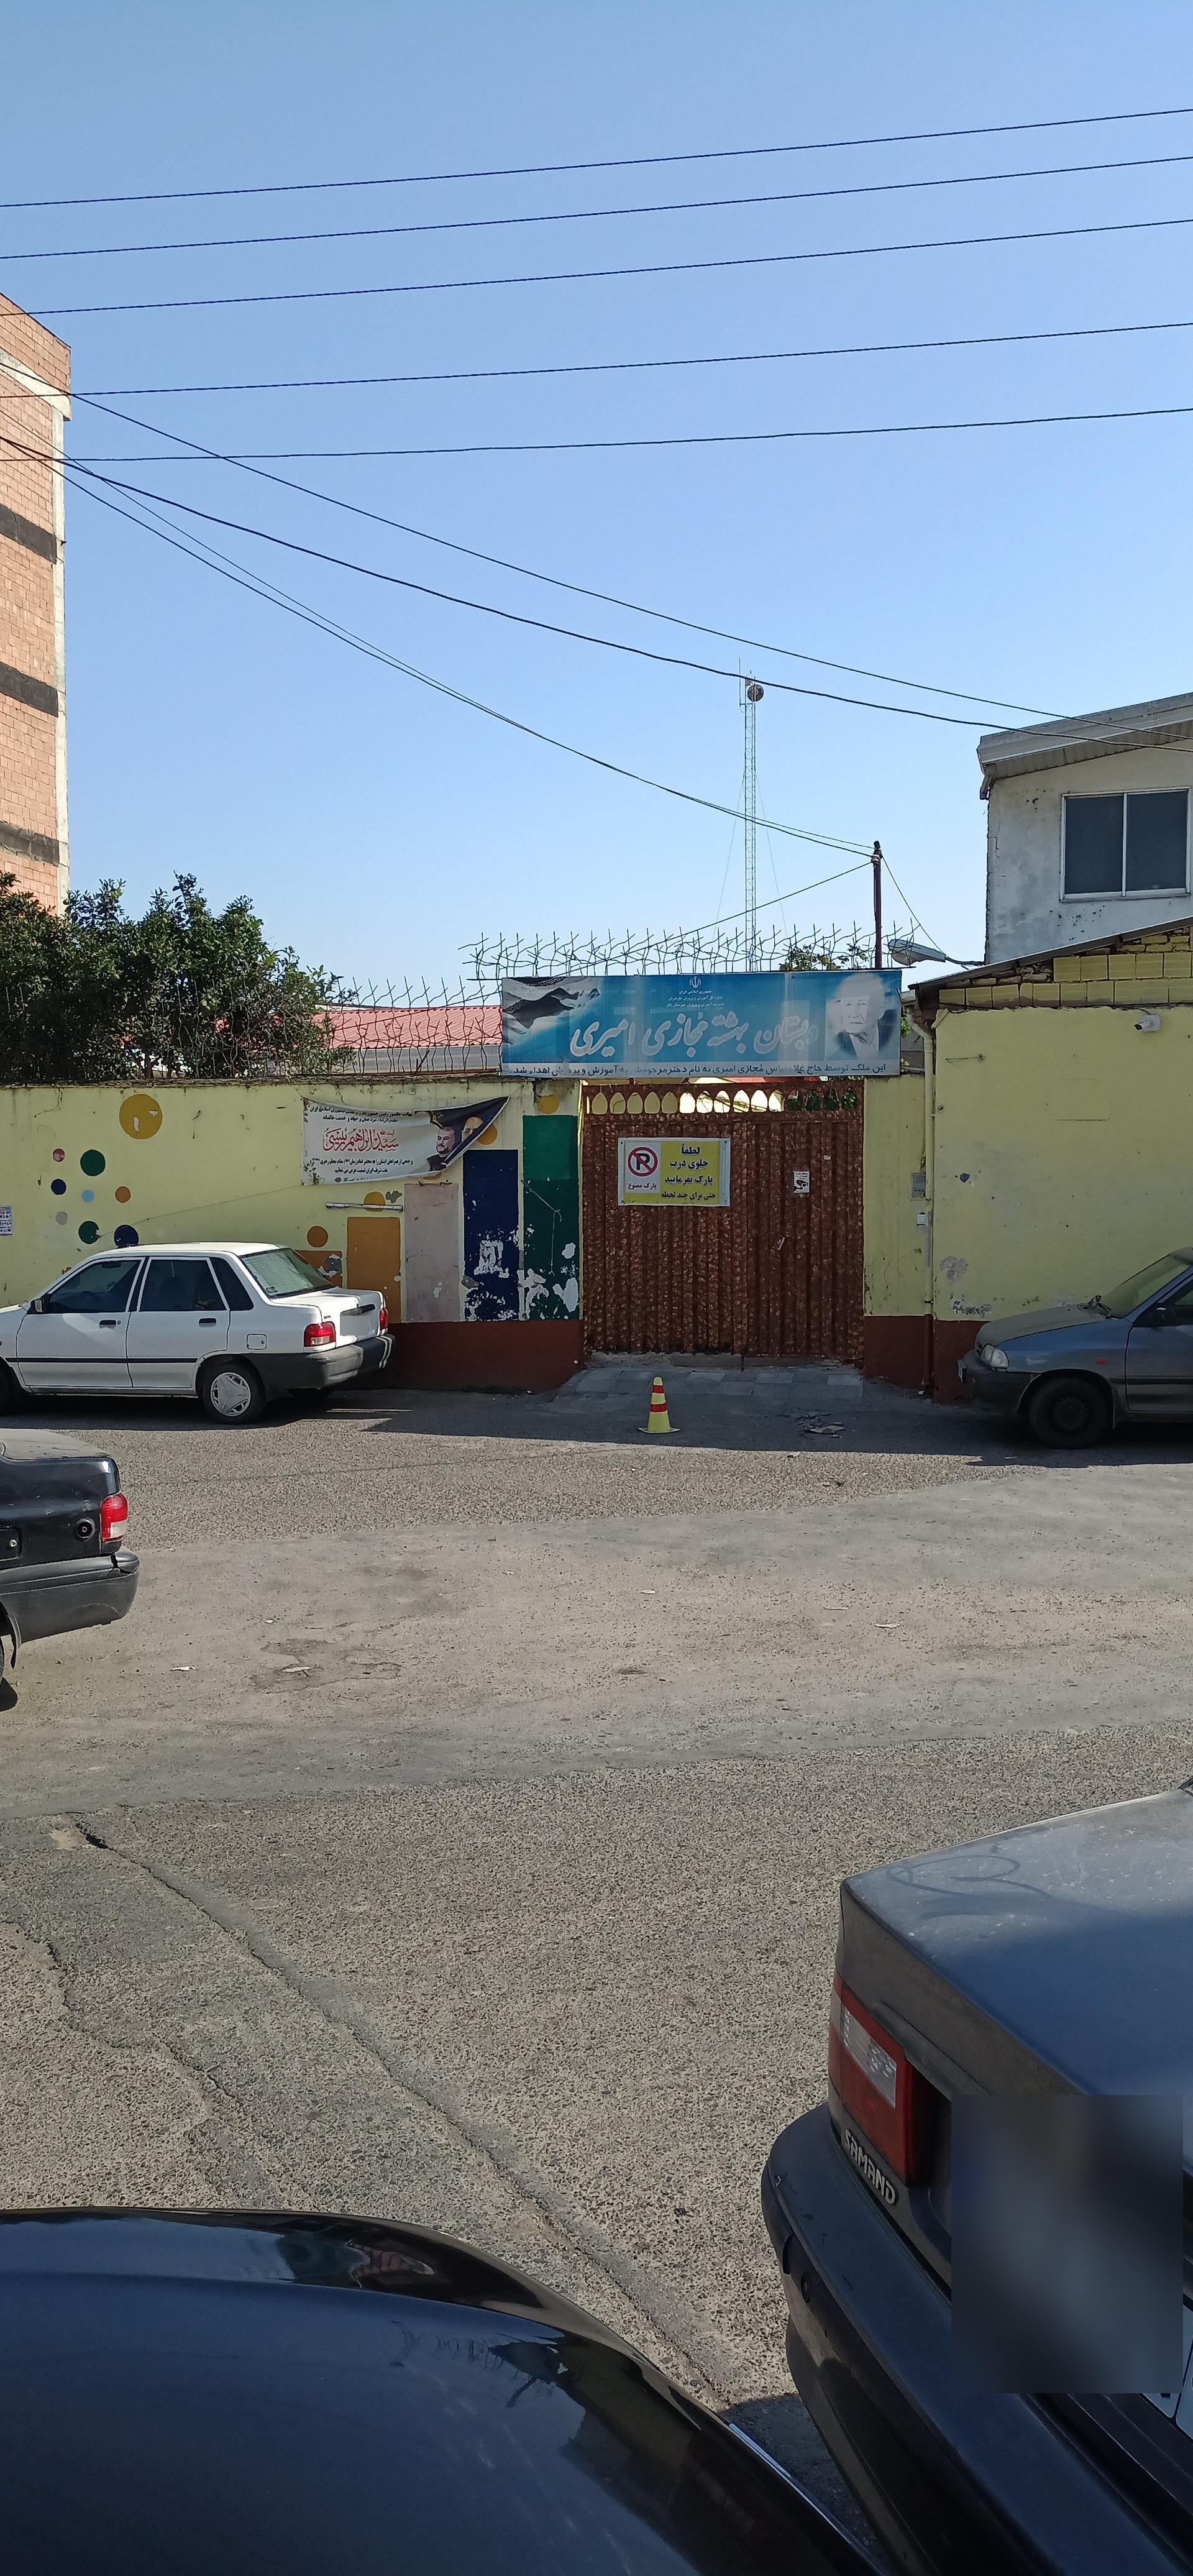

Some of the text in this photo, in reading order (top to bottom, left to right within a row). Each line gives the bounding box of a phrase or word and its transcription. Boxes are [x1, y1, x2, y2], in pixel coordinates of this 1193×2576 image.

[570, 1019, 636, 1057] امیری
[529, 1066, 550, 1075] اهداء
[588, 1065, 619, 1076] آموزش
[688, 1065, 700, 1076] نام
[713, 1065, 736, 1074] امیری
[807, 1065, 821, 1075] حاج
[825, 1064, 849, 1073] توسط
[872, 1064, 886, 1073] این
[341, 1129, 372, 1152] ابراهیم
[670, 1158, 708, 1170] جلوی درب
[665, 1175, 713, 1186] پارک نفرمایید
[690, 1192, 702, 1200] برای
[845, 2129, 896, 2205] SAMAND
